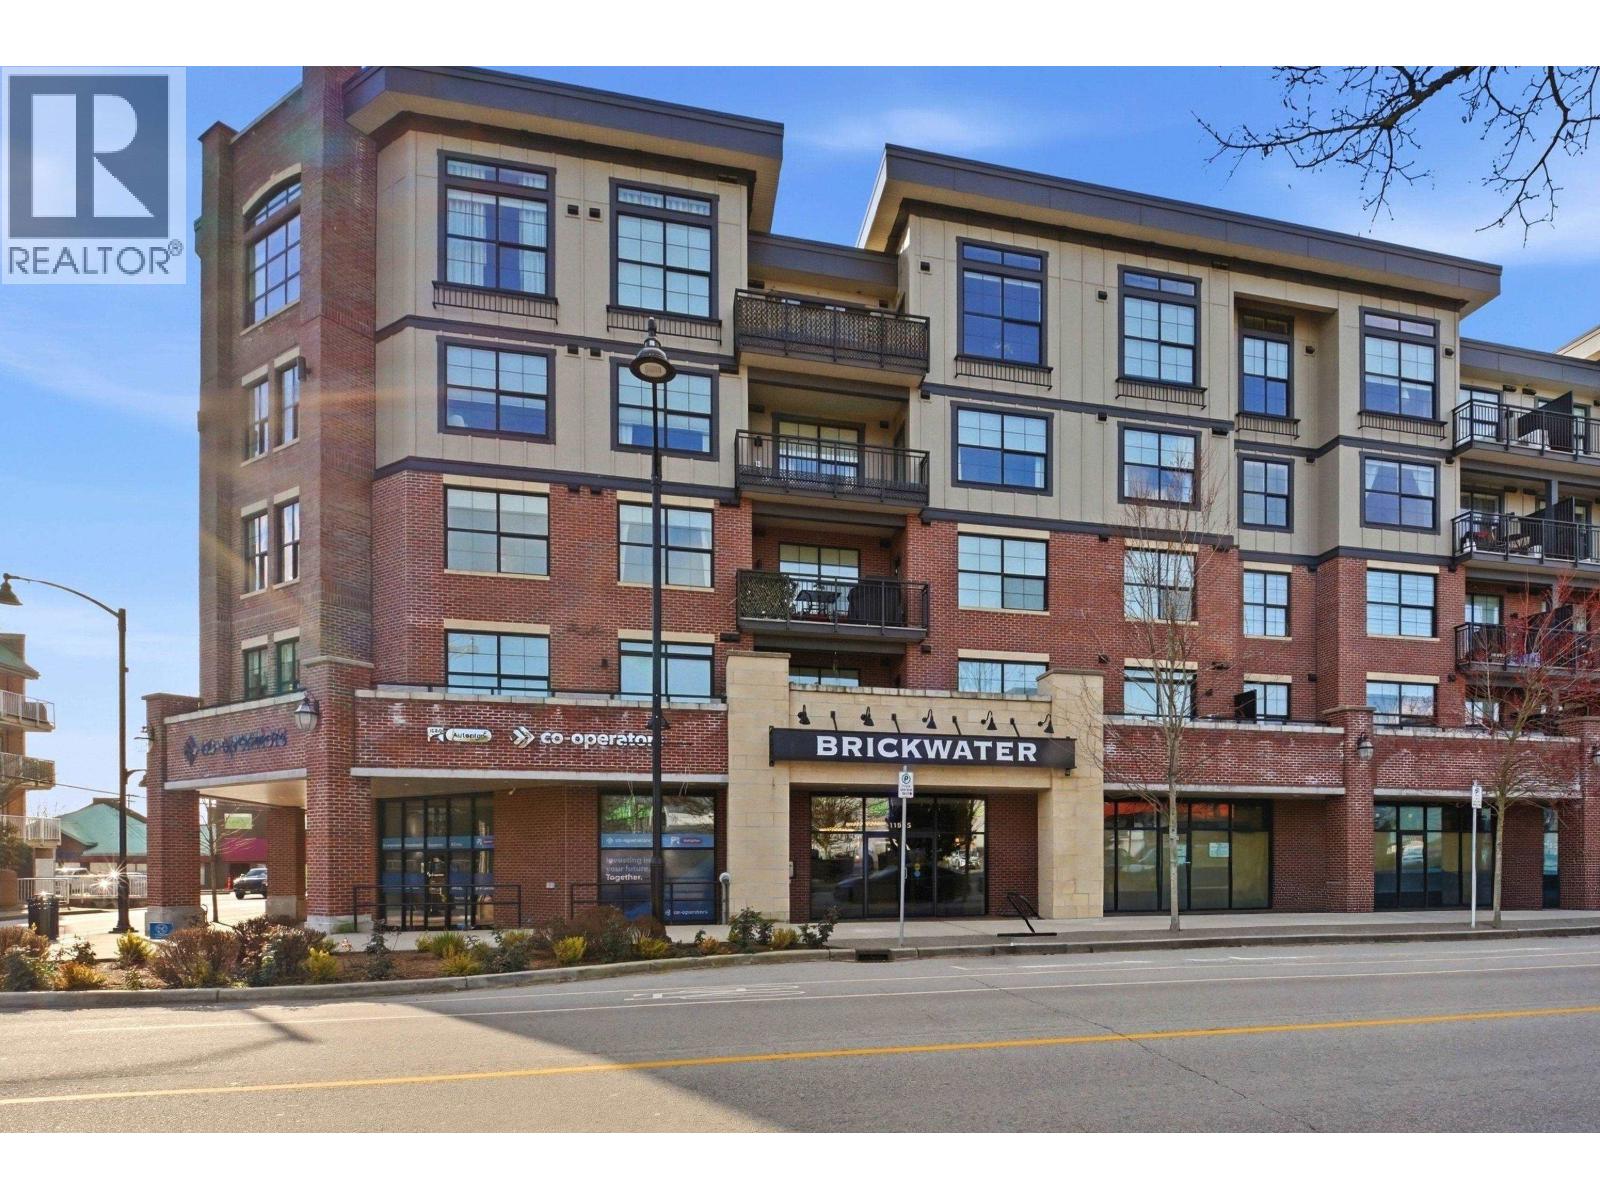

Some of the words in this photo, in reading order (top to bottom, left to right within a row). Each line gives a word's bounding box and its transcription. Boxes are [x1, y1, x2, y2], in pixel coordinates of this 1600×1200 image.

[540, 732, 664, 750] co-operator
[816, 735, 1037, 762] BRICKWATER
[605, 873, 643, 882] Together.
